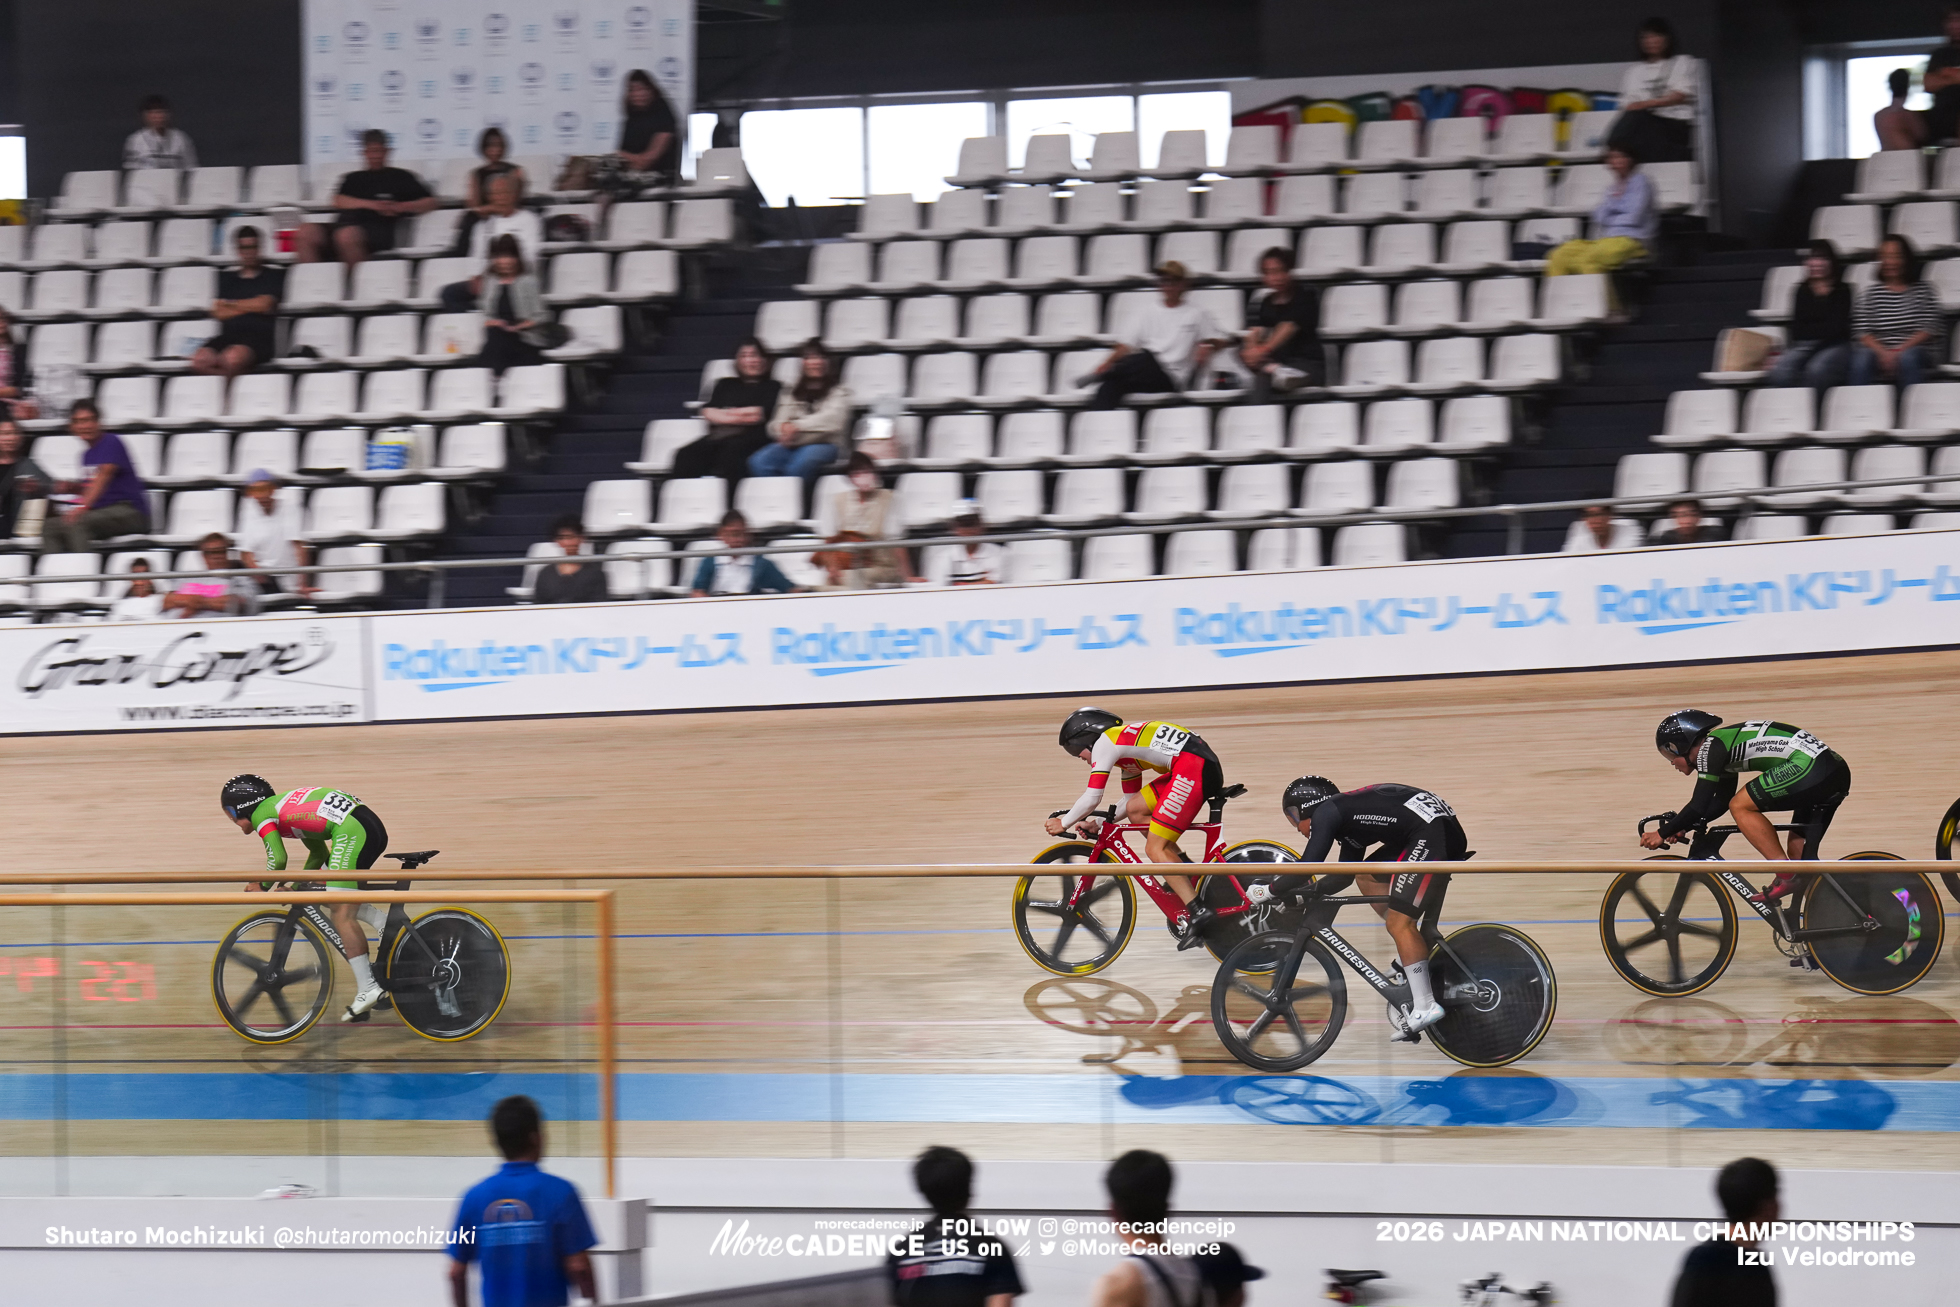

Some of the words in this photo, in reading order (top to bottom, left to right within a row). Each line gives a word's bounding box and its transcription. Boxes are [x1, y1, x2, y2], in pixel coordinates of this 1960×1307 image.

[1595, 577, 1783, 624] Rakuten
[771, 622, 942, 665] Rakuten
[1174, 602, 1353, 646] Rakuten
[17, 634, 150, 699] Gran
[150, 631, 337, 702] Compe
[382, 639, 550, 681] Rakuten
[1156, 725, 1187, 745] 319
[1748, 740, 1778, 749] Matsuyama
[1755, 745, 1768, 753] High
[1767, 745, 1786, 753] School
[236, 795, 266, 810] Kabuto
[323, 792, 353, 813] 333
[1158, 774, 1196, 820] TORIDE
[1353, 814, 1398, 824] HODOGAYA
[1318, 927, 1389, 990] BRIDGESTONE
